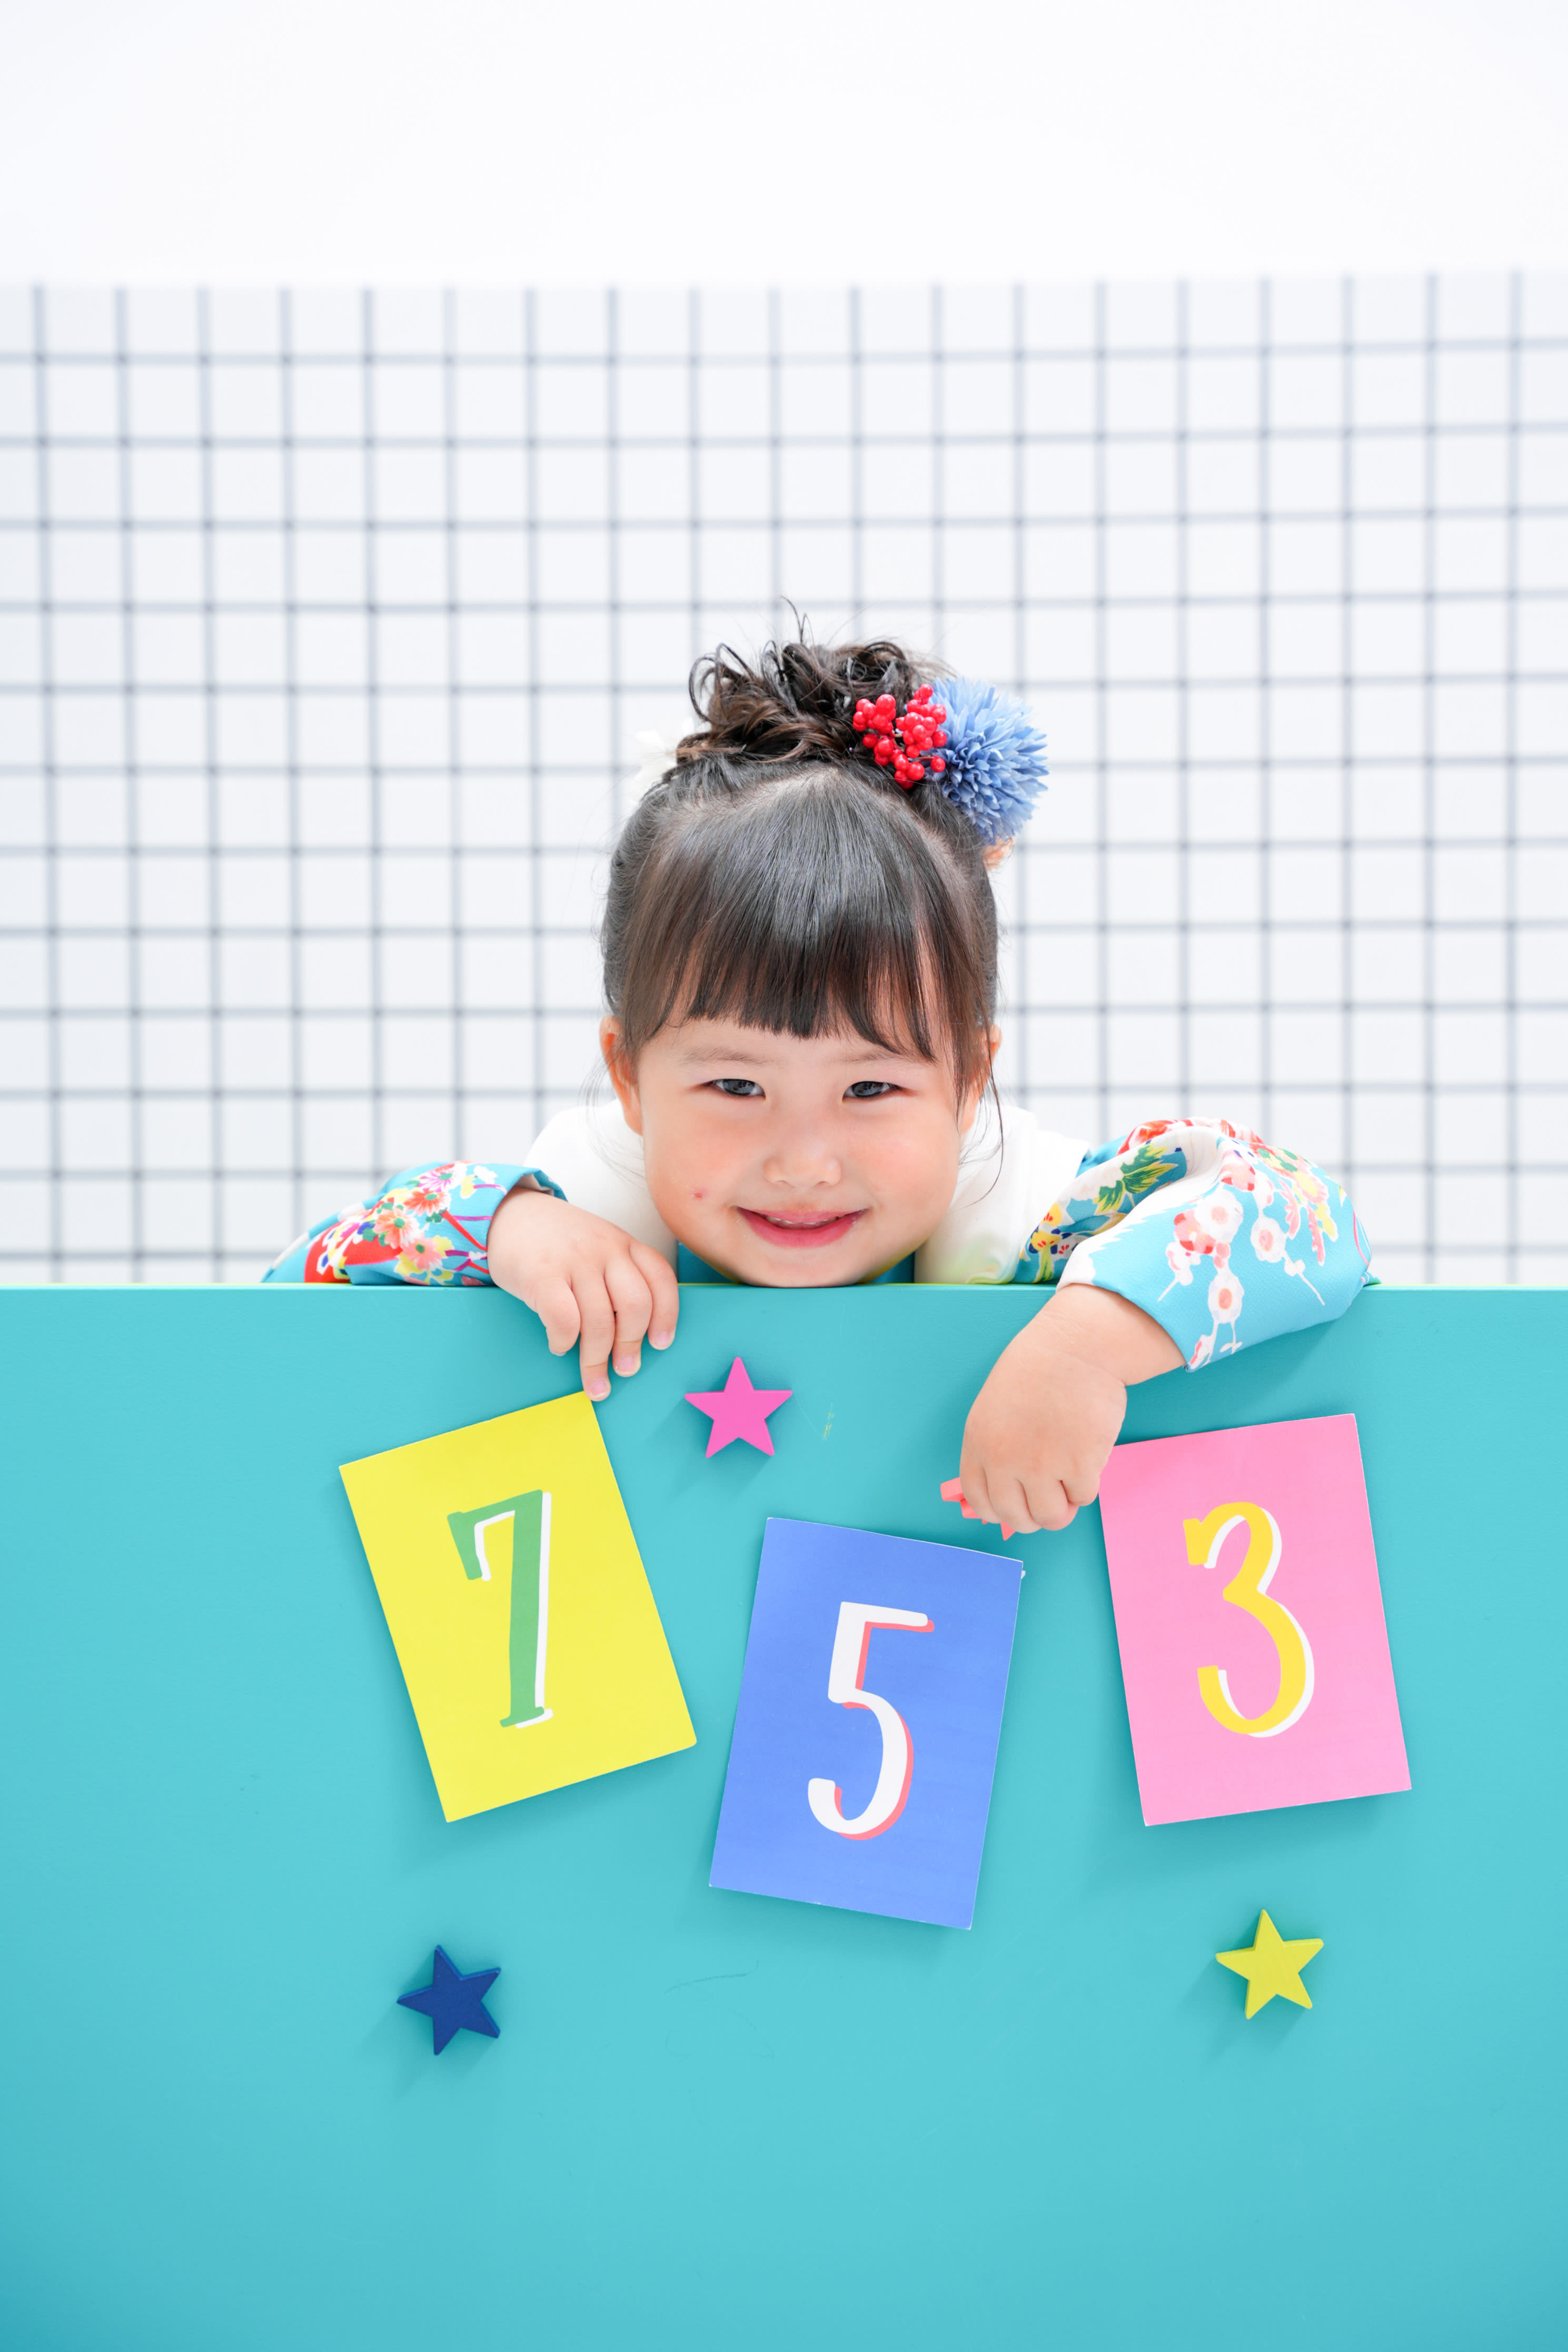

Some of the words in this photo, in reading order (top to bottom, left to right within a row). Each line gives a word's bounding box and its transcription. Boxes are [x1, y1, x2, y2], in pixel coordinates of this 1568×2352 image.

[447, 1489, 553, 1729] 7
[808, 1601, 934, 1840] 5
[1183, 1501, 1314, 1738] 3
